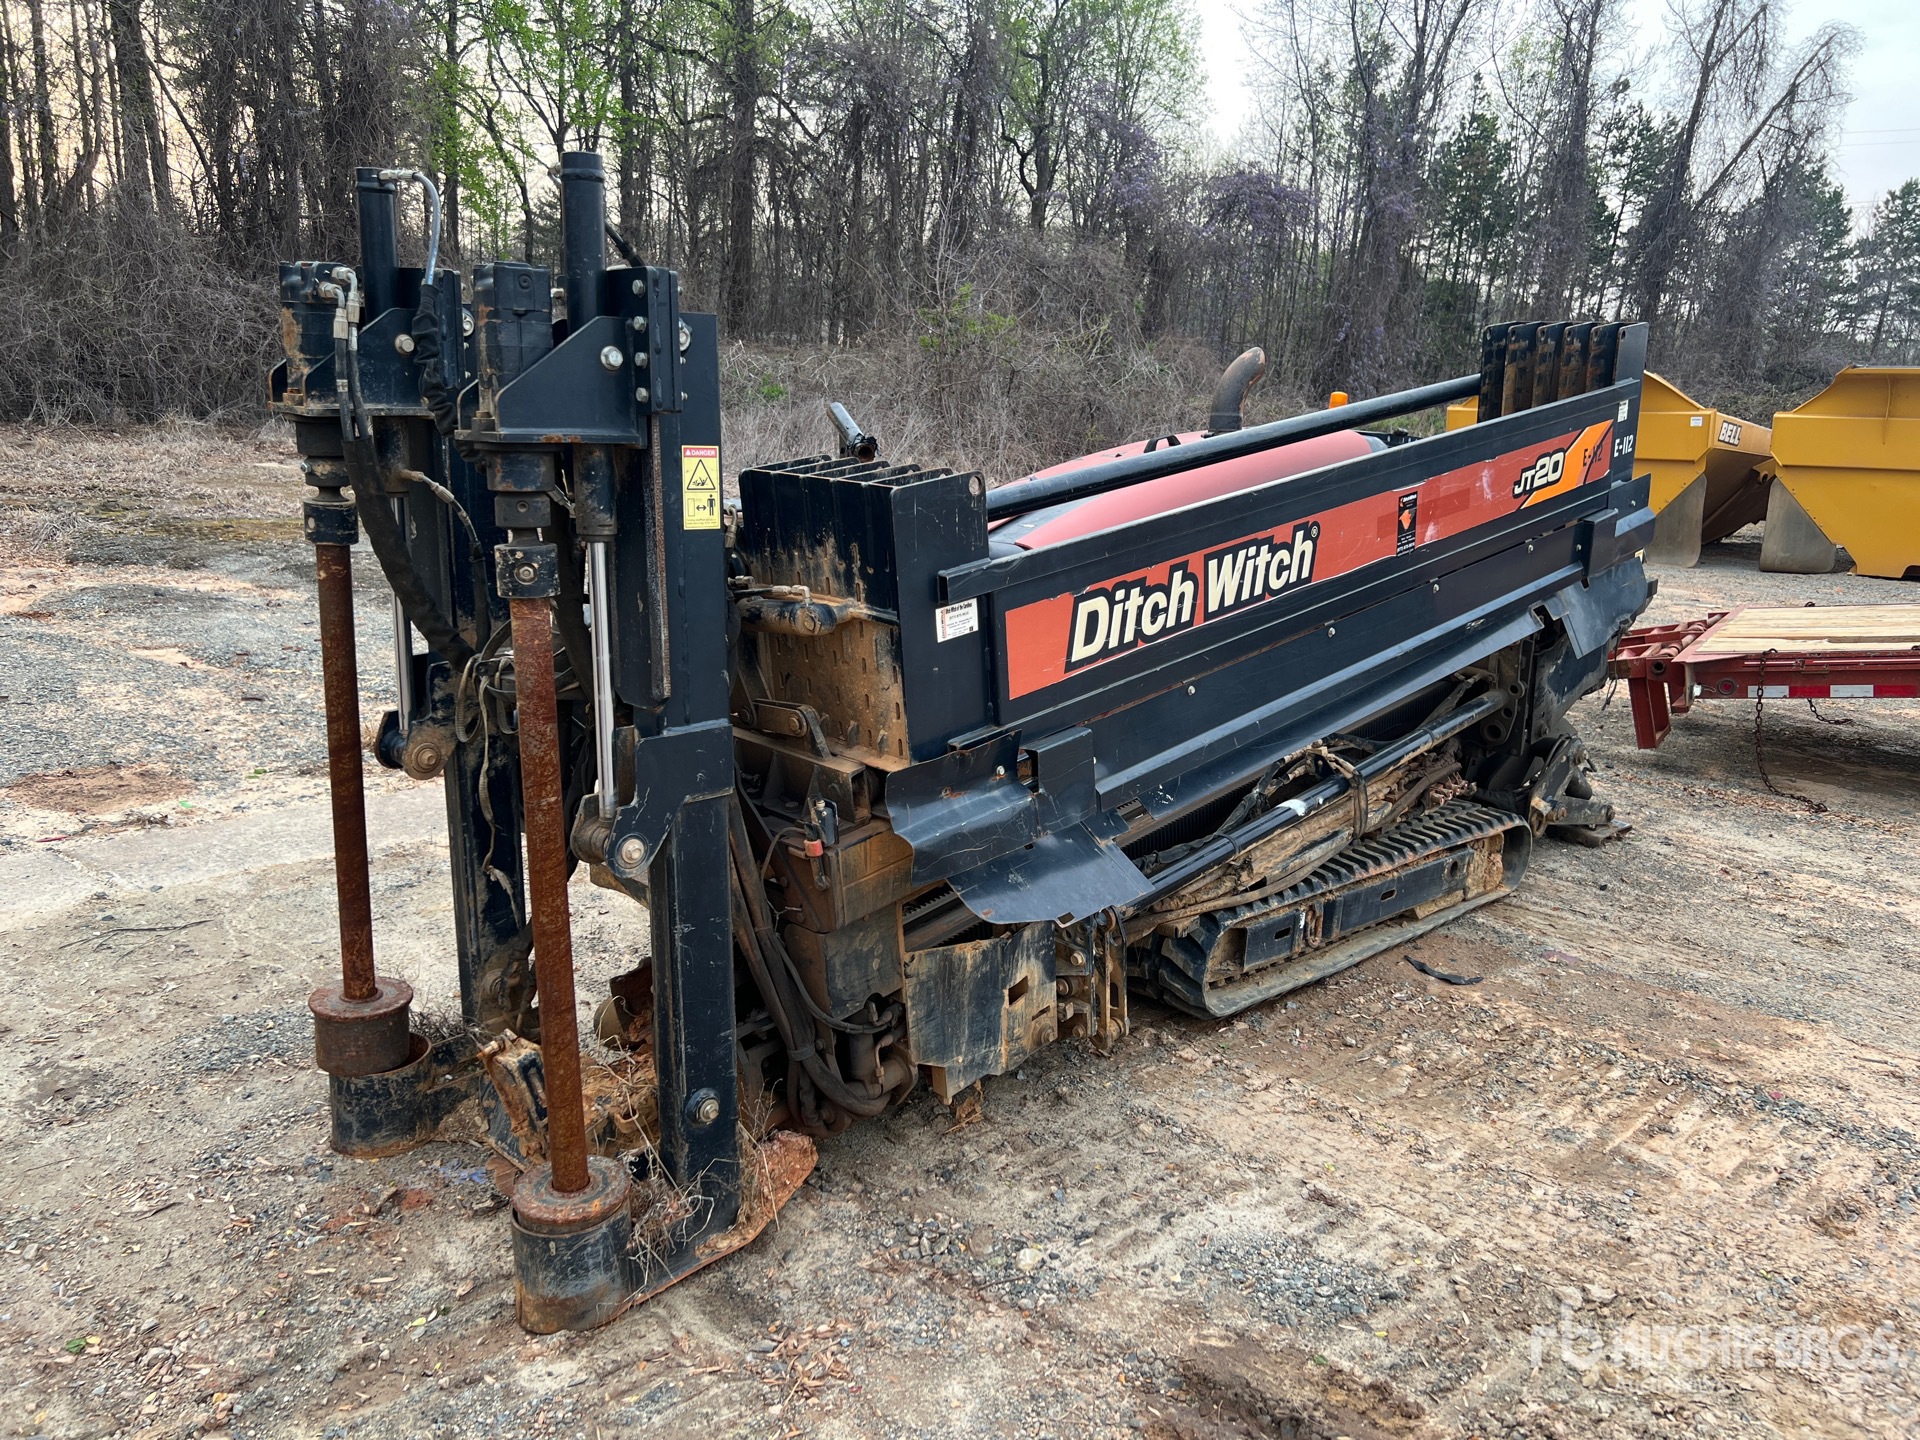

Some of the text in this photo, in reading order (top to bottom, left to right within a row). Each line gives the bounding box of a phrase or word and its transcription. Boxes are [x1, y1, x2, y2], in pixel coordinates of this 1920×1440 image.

[1718, 421, 1742, 445] BELL
[691, 449, 716, 457] DANGER
[1613, 434, 1634, 458] E-112
[1513, 451, 1565, 495] JT20
[1071, 569, 1195, 663] Ditch
